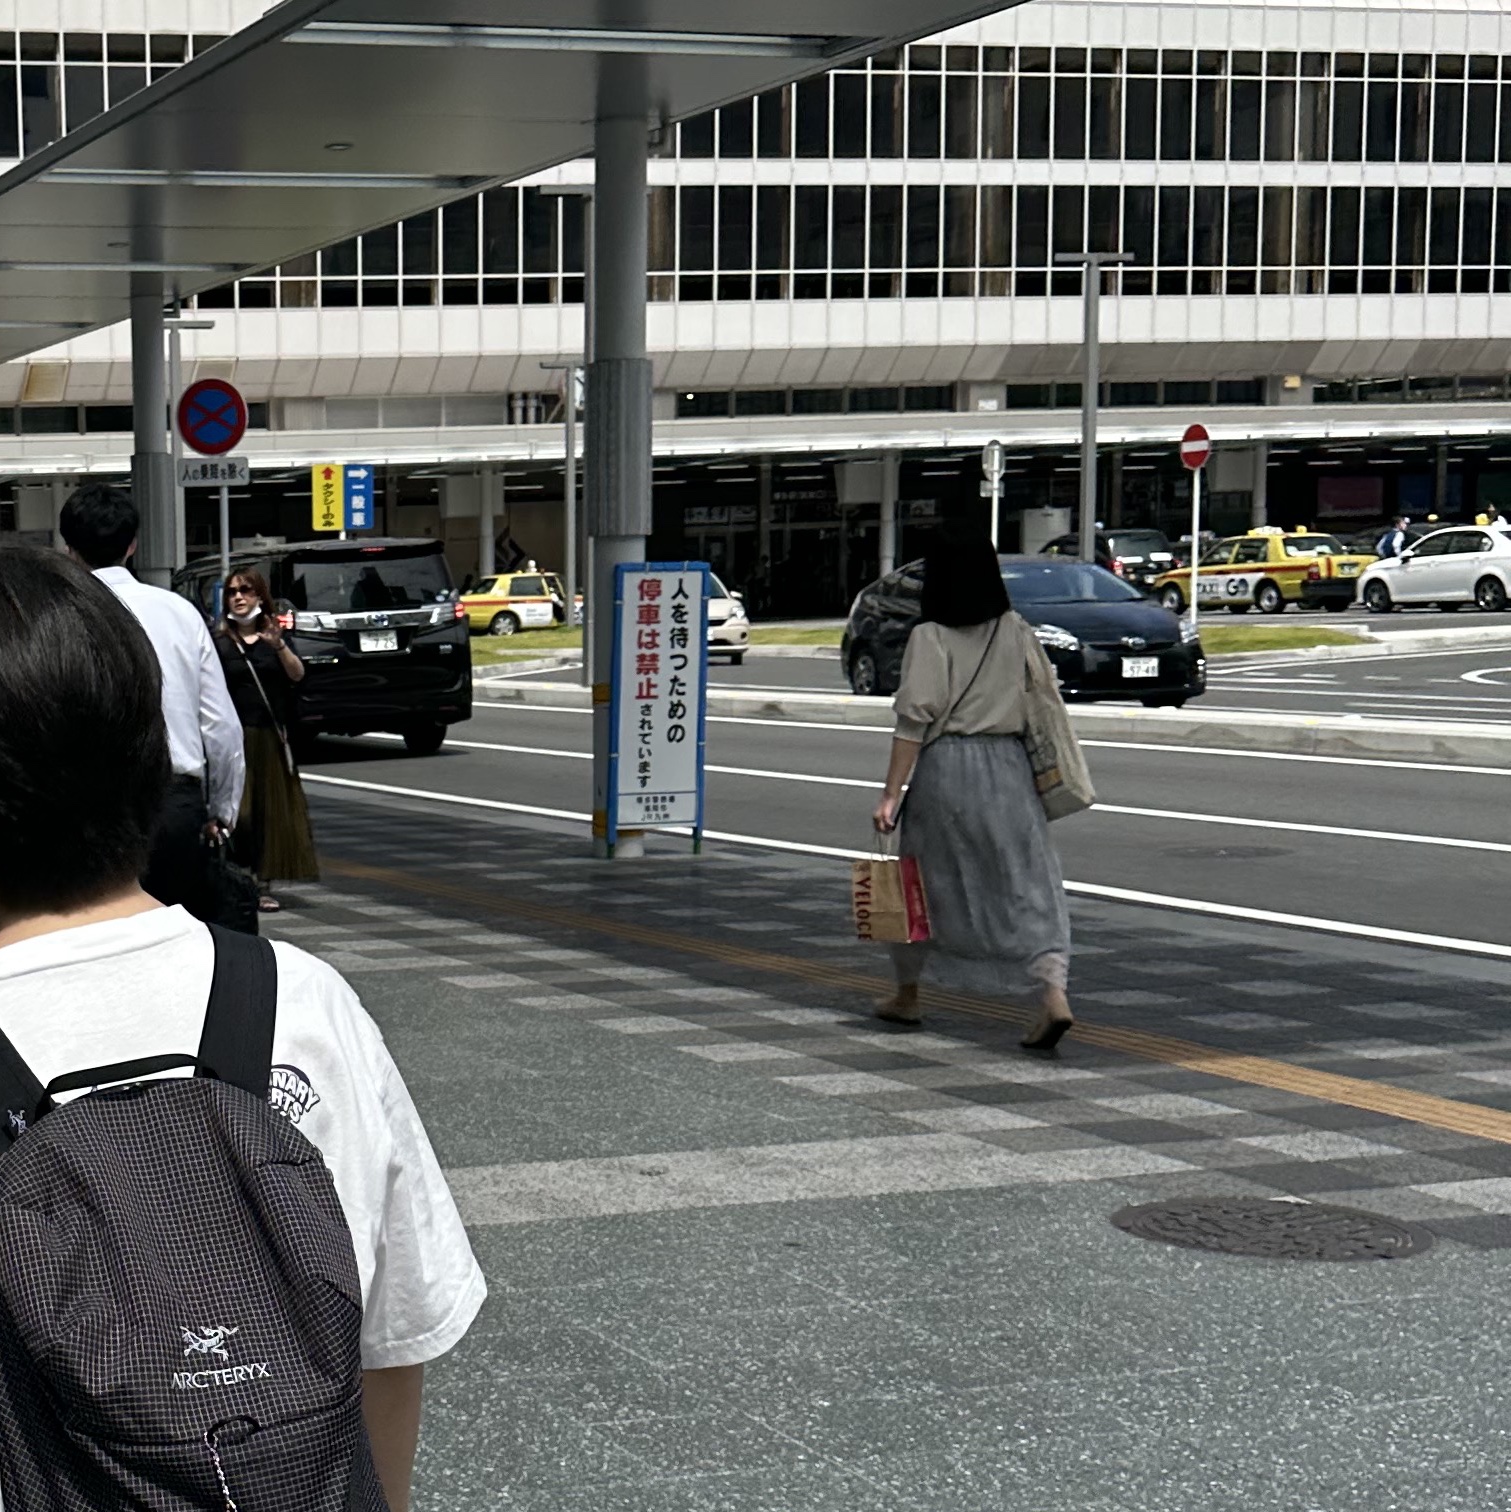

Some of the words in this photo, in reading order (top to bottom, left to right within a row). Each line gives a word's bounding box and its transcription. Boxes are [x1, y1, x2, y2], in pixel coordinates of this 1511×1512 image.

[182, 463, 246, 481] 人の乗降を除く
[666, 578, 689, 743] 人を待つための
